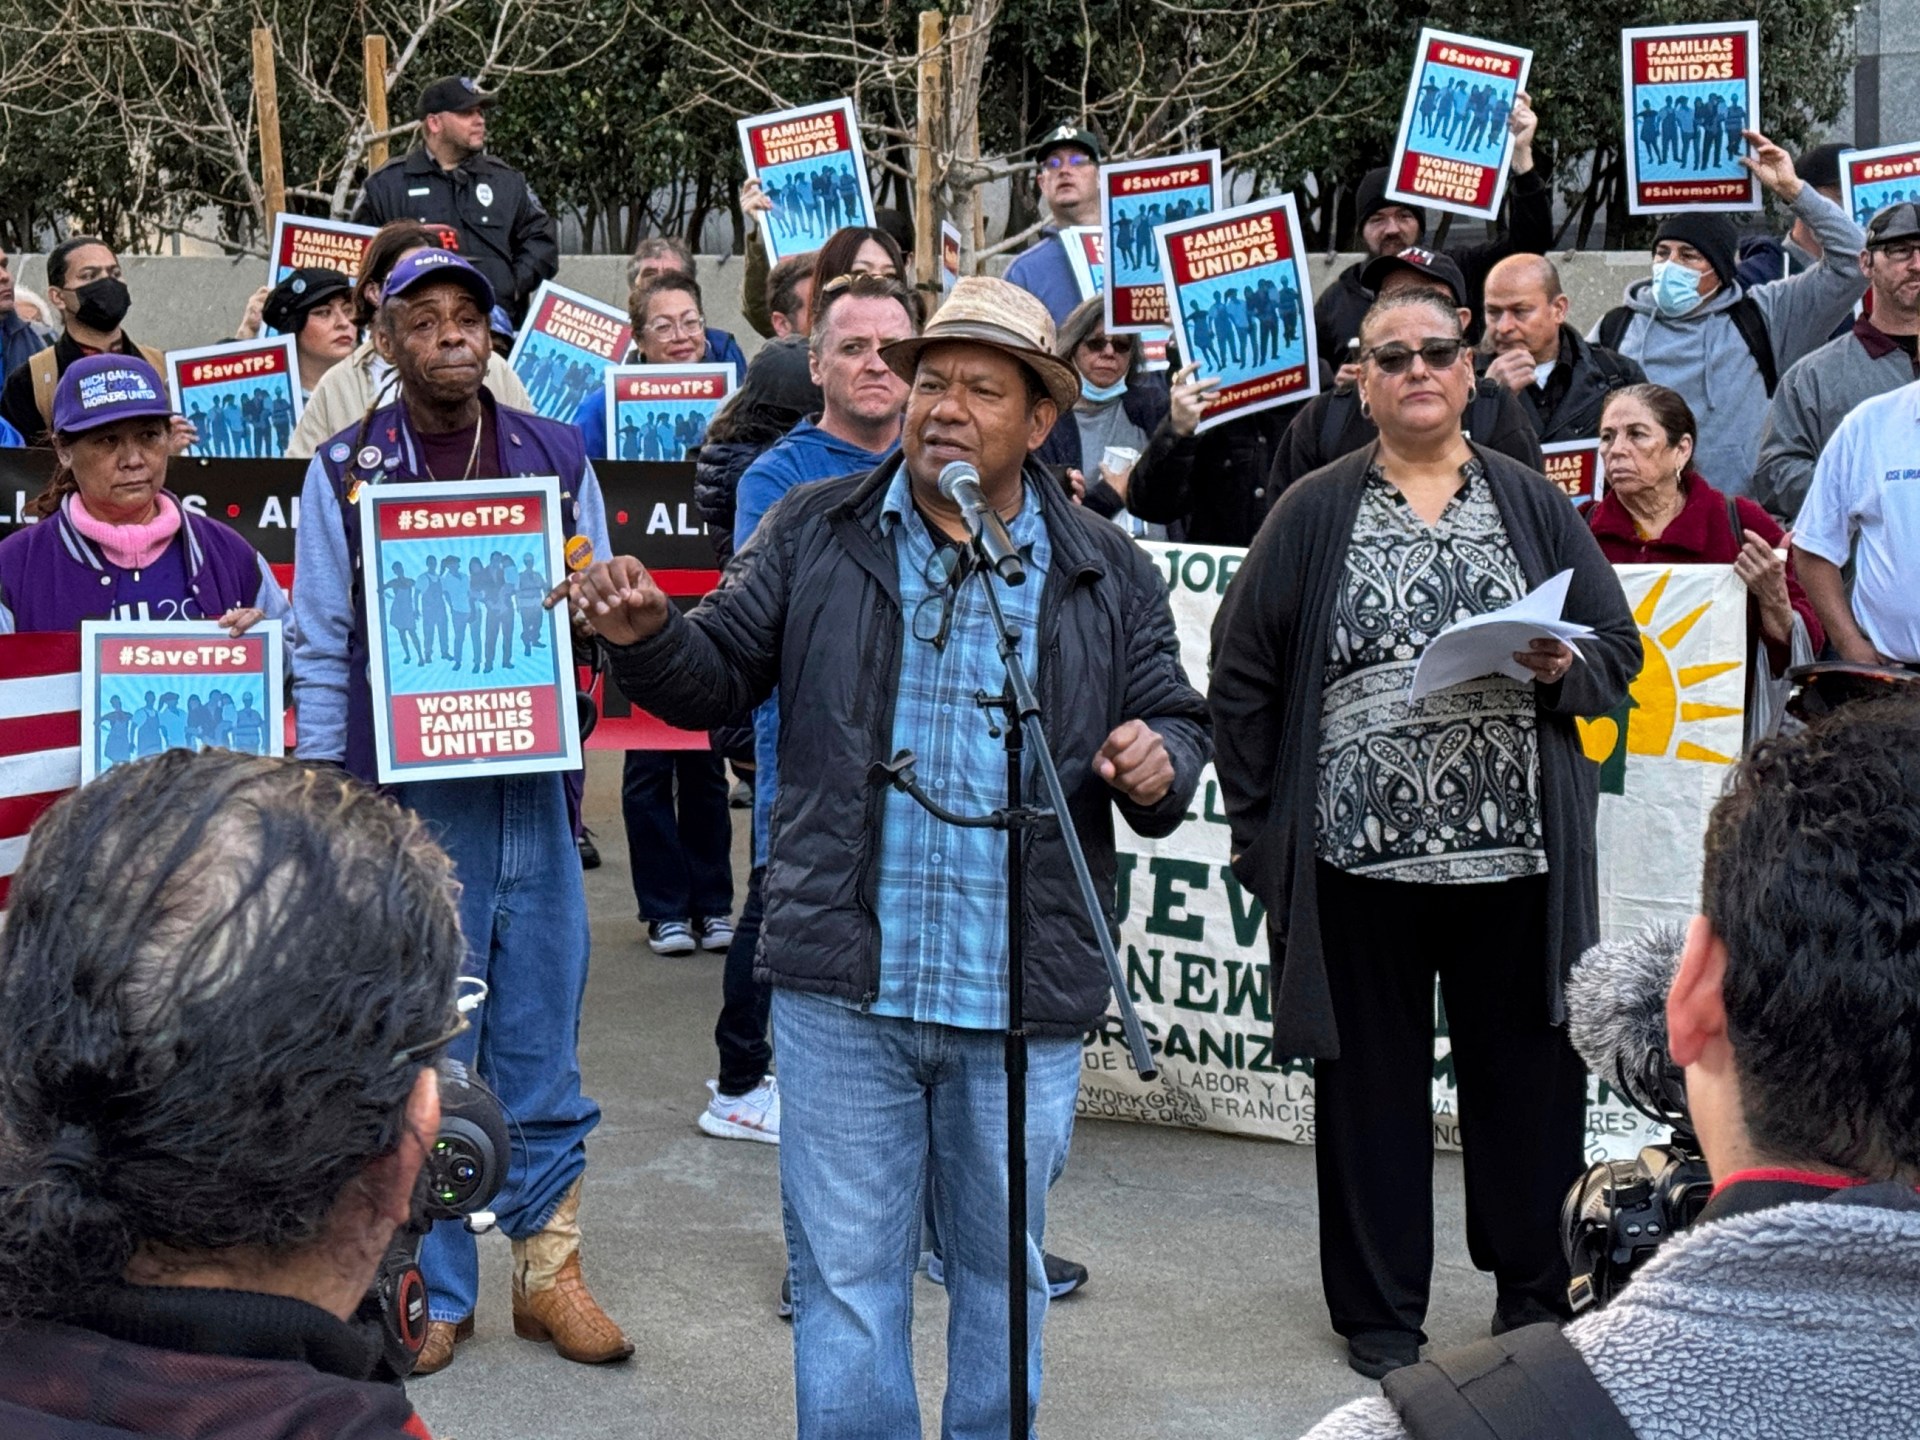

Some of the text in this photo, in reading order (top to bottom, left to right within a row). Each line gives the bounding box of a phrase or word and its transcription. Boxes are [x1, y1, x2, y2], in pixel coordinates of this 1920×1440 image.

[1647, 37, 1734, 56] FAMILIAS
[1647, 52, 1734, 66] TRABAJADORAS
[1438, 46, 1512, 74] #SaveTPS
[1648, 62, 1734, 83] UNIDAS
[761, 115, 836, 142] FAMILIAS
[763, 128, 837, 150] TRABAJADORAS
[765, 136, 840, 165] UNIDAS
[1416, 166, 1482, 190] FAMILIES
[1419, 154, 1484, 178] WORKING
[1122, 168, 1200, 191] #SaveTPS
[1413, 177, 1478, 202] UNITED
[1644, 184, 1745, 198] #SalvemosTPS
[293, 229, 363, 253] FAMILIAS
[1183, 216, 1274, 252] FAMILIAS
[1185, 231, 1276, 261] TRABAJADORAS
[293, 242, 361, 260] TRABAJADORAS
[1188, 242, 1279, 280] UNIDAS
[291, 252, 361, 277] UNIDAS
[550, 311, 619, 345] TRABAJADORAS
[553, 299, 623, 337] FAMILIAS
[545, 319, 614, 358] UNIDAS
[192, 354, 275, 381] #SaveTPS
[629, 379, 714, 396] #SaveTPS
[1545, 455, 1583, 472] LIAS
[397, 504, 526, 531] #SaveTPS
[119, 645, 247, 666] #SaveTPS
[416, 691, 533, 715] WORKING
[420, 709, 533, 734] FAMILIES
[420, 729, 535, 757] UNITED
[1084, 1051, 1118, 1070] DE
[1177, 1068, 1250, 1095] LABOR
[1261, 1081, 1275, 1100] Y
